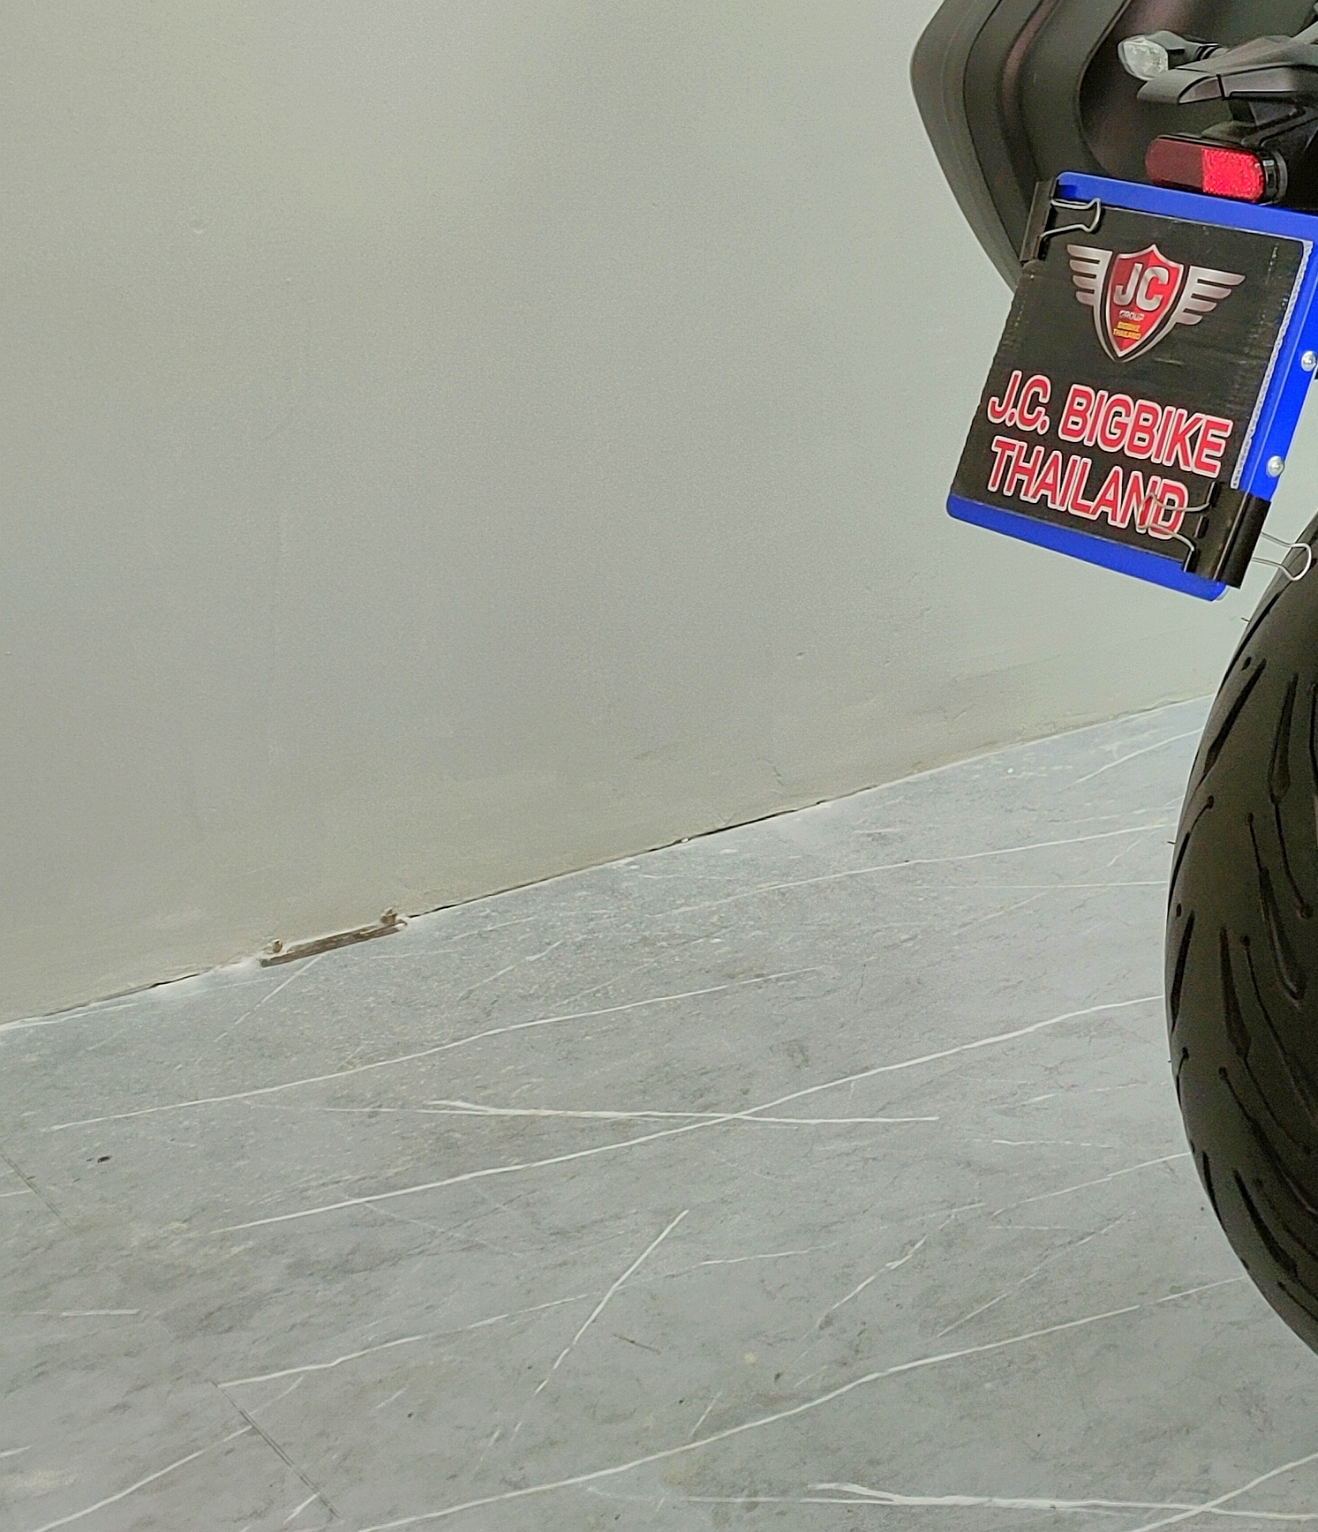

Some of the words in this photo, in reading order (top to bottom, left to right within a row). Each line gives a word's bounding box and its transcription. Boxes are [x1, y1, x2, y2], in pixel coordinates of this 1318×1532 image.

[1113, 263, 1169, 312] JC
[988, 370, 1051, 434] J.C.
[1058, 384, 1233, 478] BIGBIKE
[988, 435, 1189, 540] THAILAND
